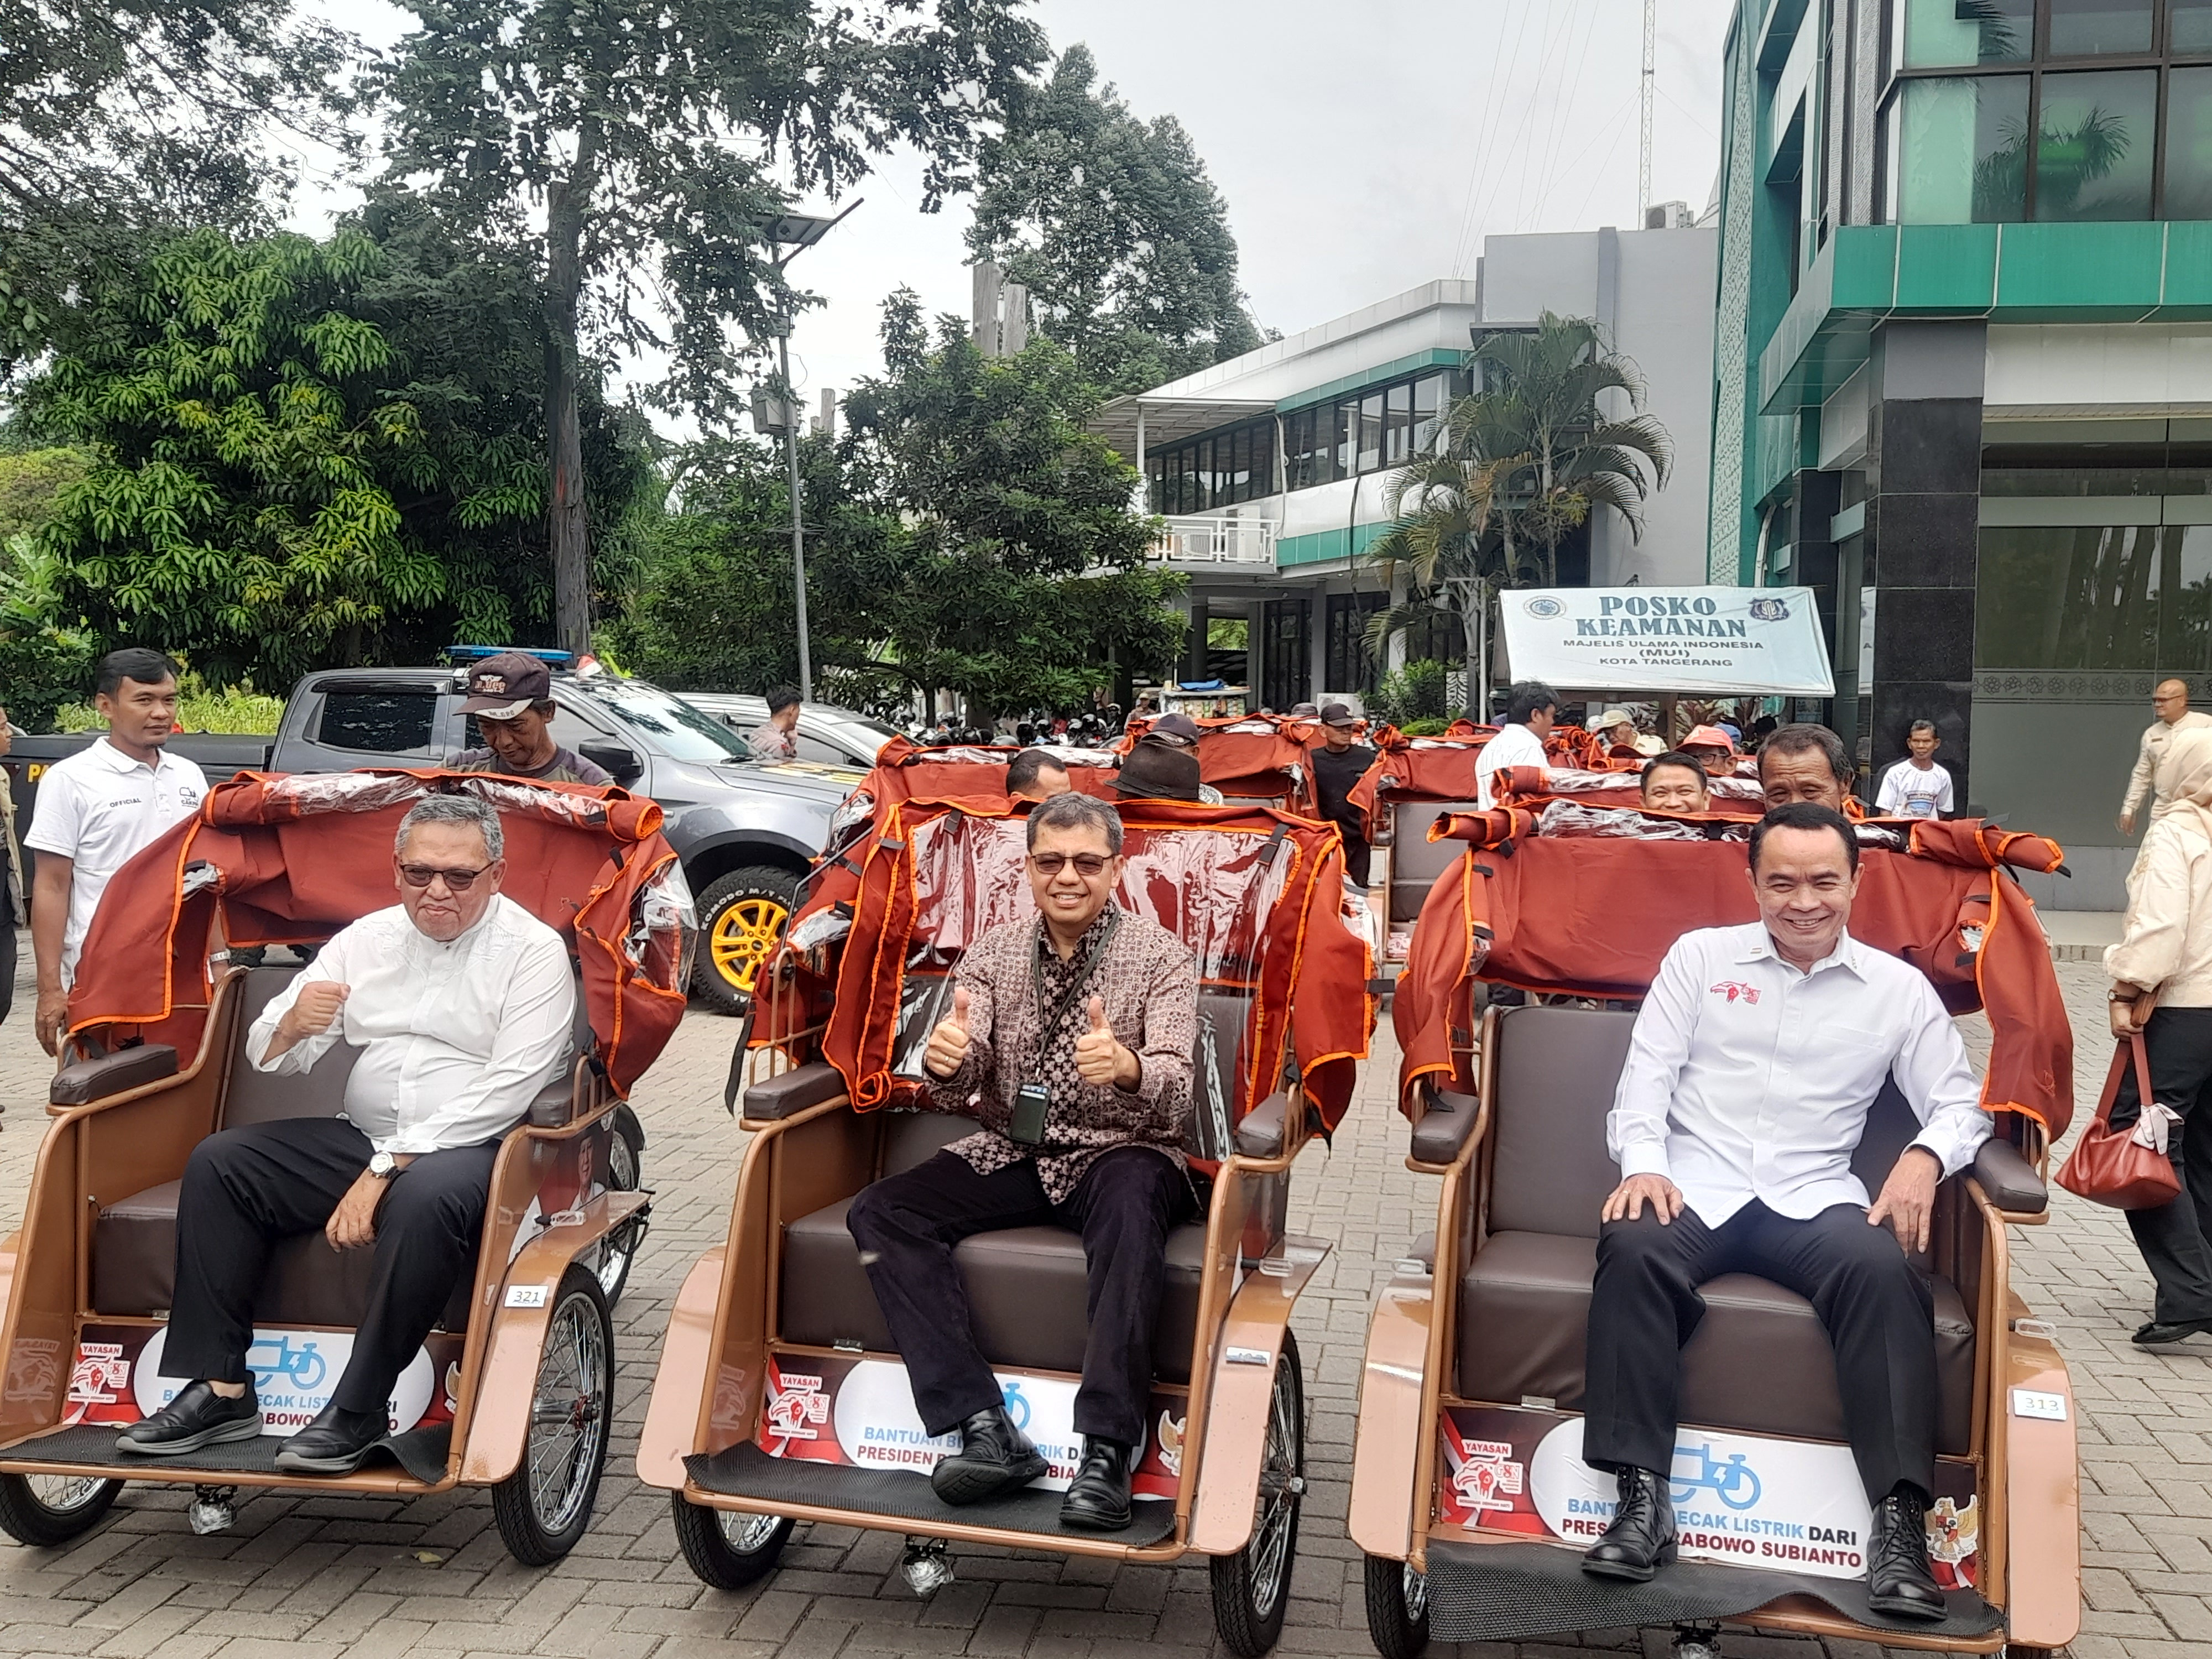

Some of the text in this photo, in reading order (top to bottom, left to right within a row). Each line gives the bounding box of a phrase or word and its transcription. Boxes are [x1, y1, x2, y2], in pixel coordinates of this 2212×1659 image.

[1599, 596, 1717, 616] POSKO
[1576, 618, 1746, 638] KEAMANAN
[1683, 641, 1764, 649] INDONESIA
[1639, 649, 1691, 658] (MUI)
[109, 797, 142, 808] OFFICIAL
[700, 889, 745, 931] KOMODO
[748, 887, 776, 898] M/T
[514, 1291, 539, 1302] 321
[84, 1345, 120, 1354] YAYASAN
[782, 1376, 819, 1387] YAYASAN
[257, 1394, 294, 1408] ECAK
[299, 1396, 331, 1409] LIST
[2025, 1397, 2059, 1411] 313
[864, 1426, 942, 1447] BANTUAN
[857, 1445, 933, 1465] PRESIDEN
[1465, 1442, 1509, 1454] YAYASAN
[1567, 1499, 1857, 1546] BANT ECAK LISTRIK DARI
[1562, 1519, 1607, 1536] PRES
[1761, 1541, 1861, 1568] SUBIANTO
